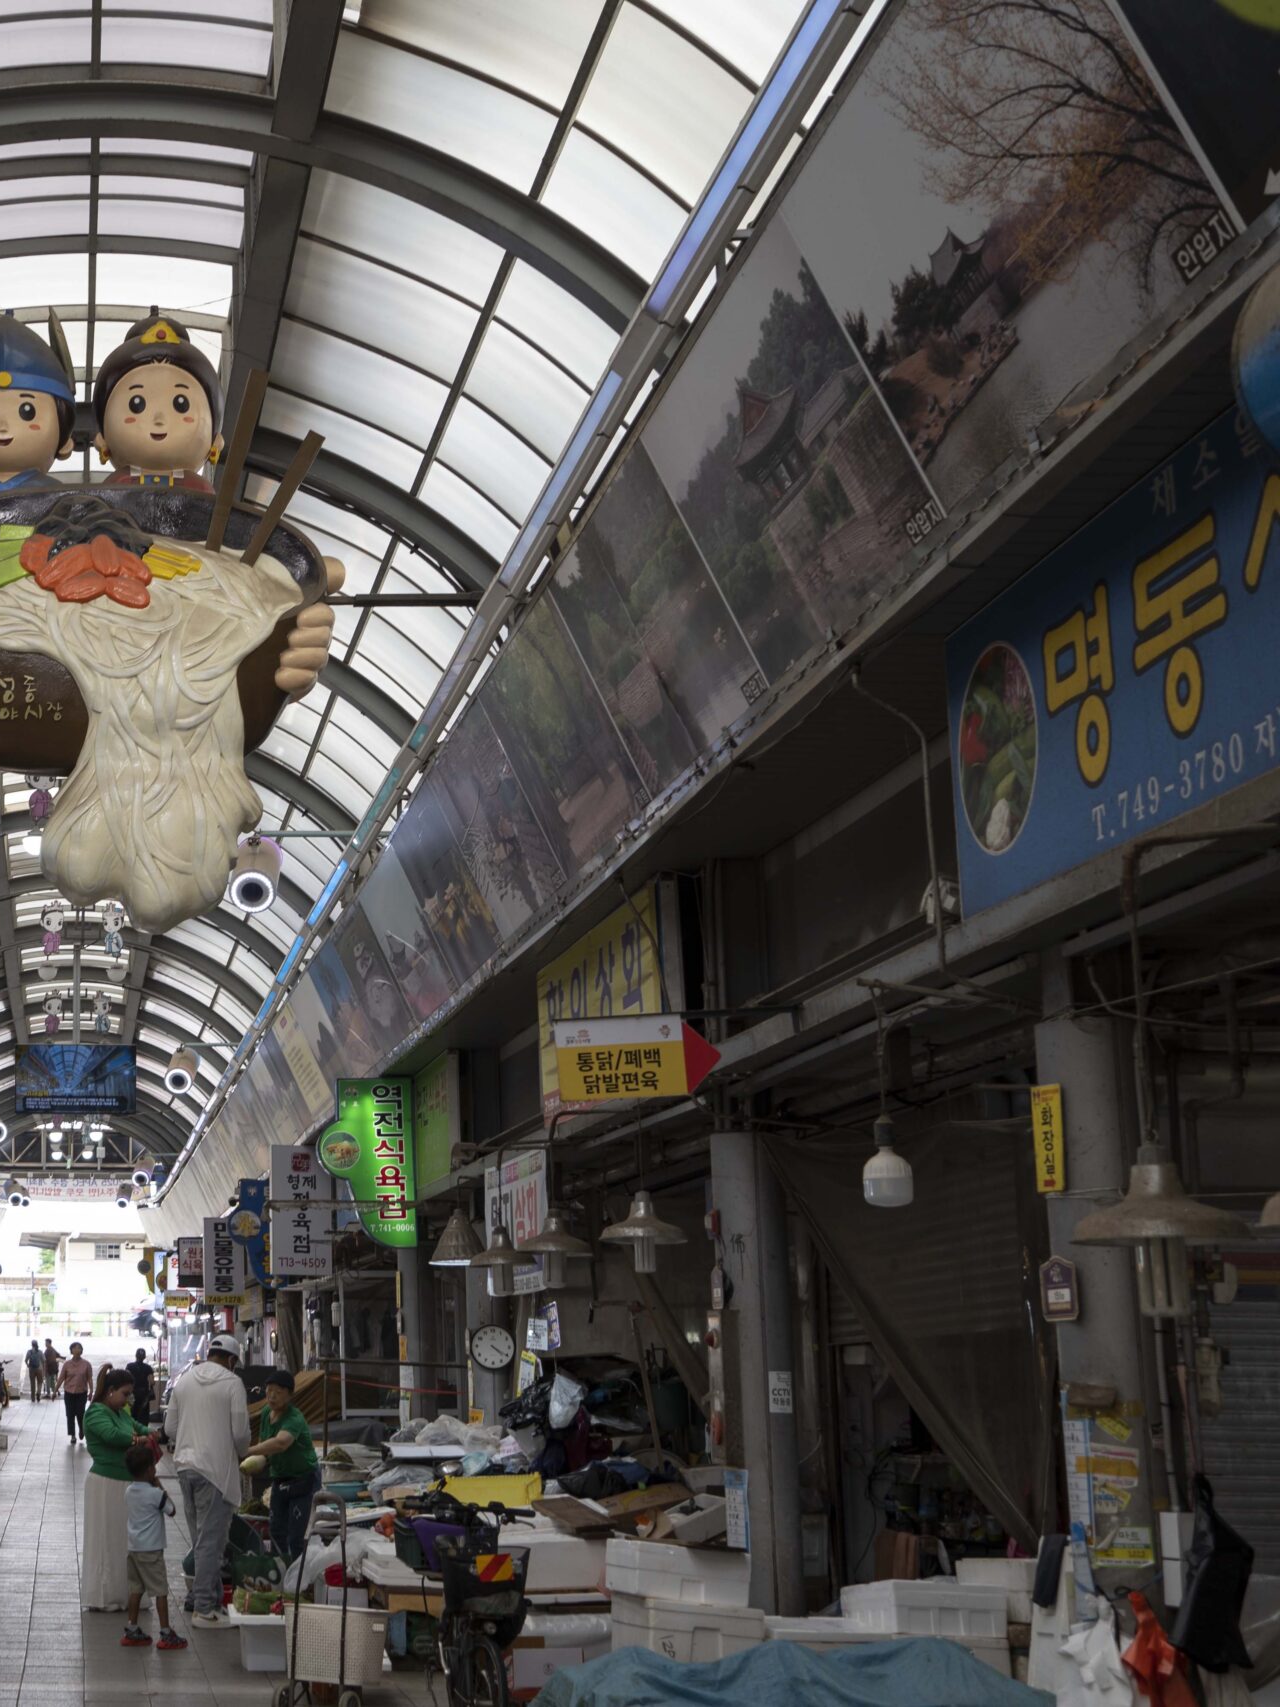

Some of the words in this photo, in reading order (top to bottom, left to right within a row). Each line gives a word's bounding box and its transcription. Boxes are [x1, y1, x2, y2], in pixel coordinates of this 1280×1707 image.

[1172, 209, 1238, 283] 안압지
[905, 498, 943, 544] 안압지
[1043, 474, 1280, 786] 명동
[1091, 733, 1244, 842] T.749-3780
[576, 1048, 662, 1073] 통닭/폐백
[583, 1071, 659, 1095] 닭발편육
[371, 1084, 408, 1221] 역전식육점
[286, 1174, 317, 1191] 형제
[291, 1192, 312, 1255] 정육점
[370, 1223, 415, 1233] T.741-0006
[213, 1221, 235, 1293] 민물유통
[278, 1256, 327, 1268] 773-4509
